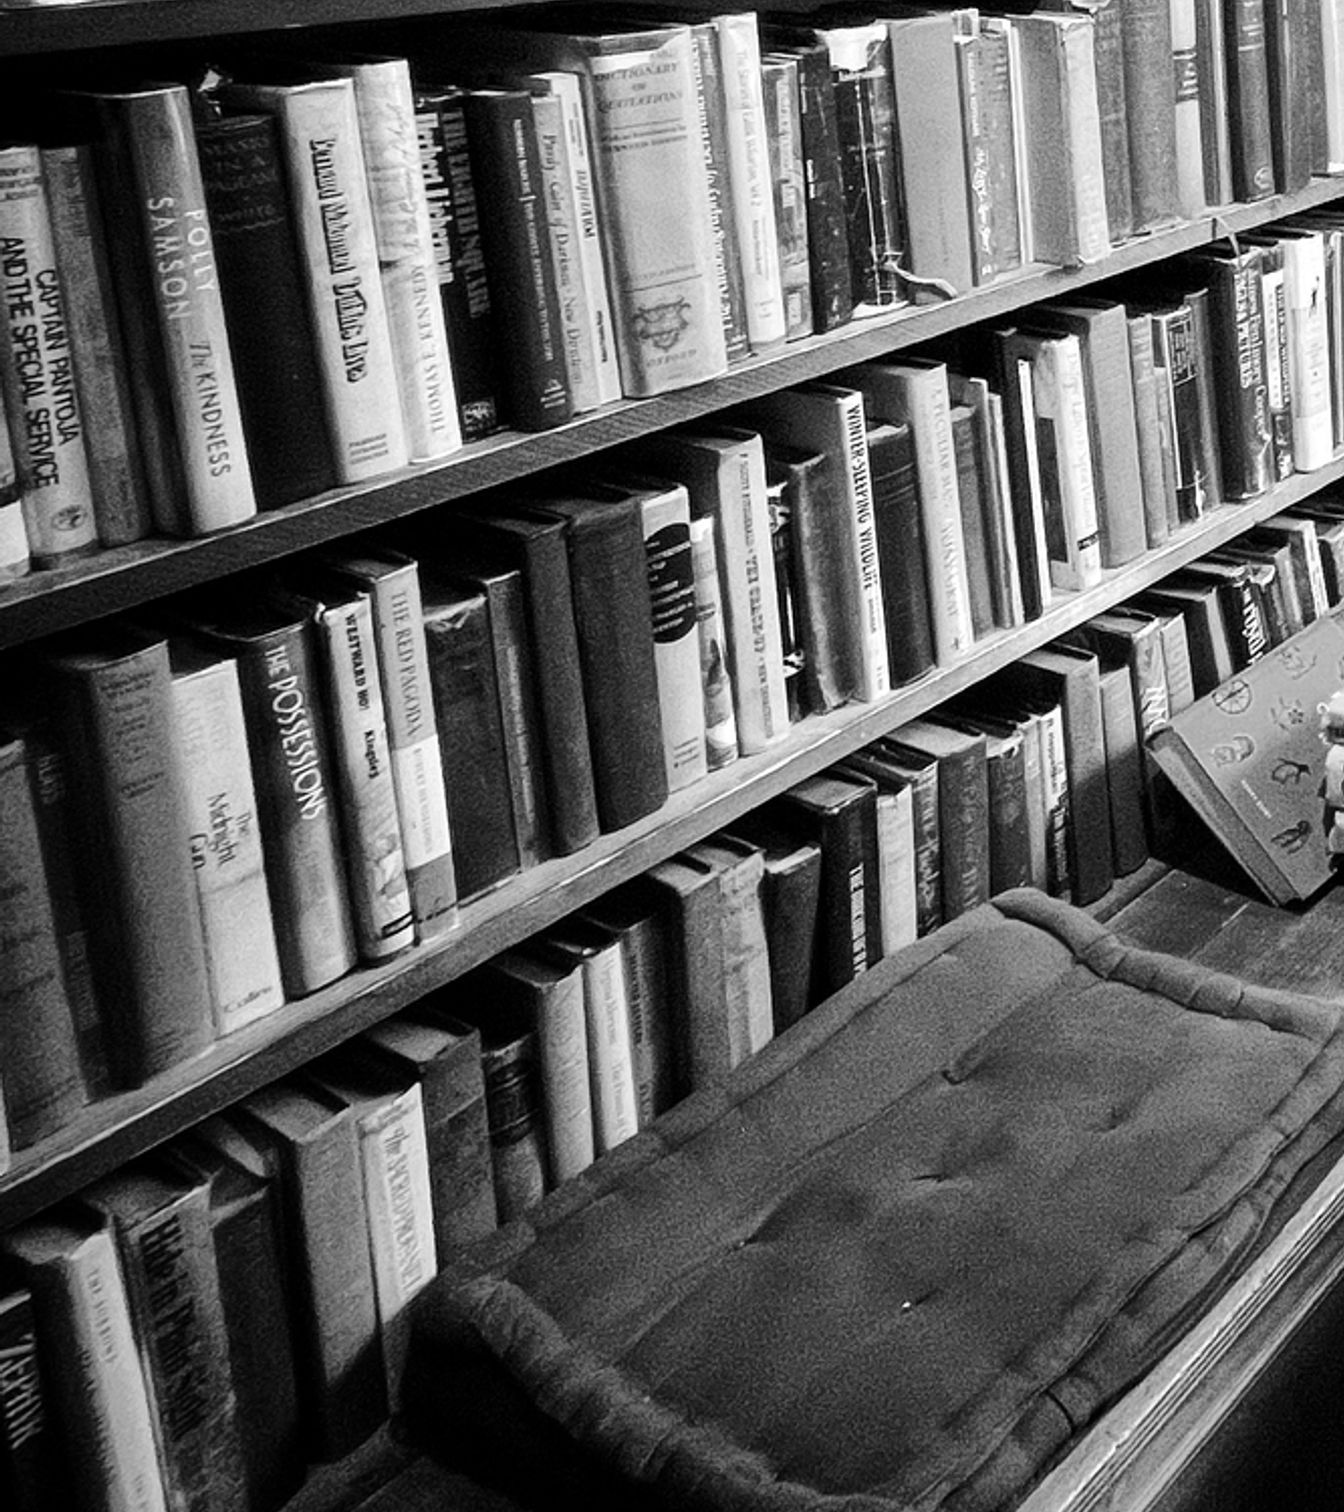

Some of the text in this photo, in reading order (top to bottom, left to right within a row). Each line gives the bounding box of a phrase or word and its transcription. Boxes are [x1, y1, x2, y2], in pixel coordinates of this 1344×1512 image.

[310, 139, 344, 199] Bernard
[416, 112, 445, 186] Herbert
[0, 238, 28, 277] AND
[146, 196, 191, 319] SAMSON
[184, 209, 216, 292] POLLY
[321, 203, 357, 275] Malamud
[5, 278, 34, 319] THE
[411, 263, 433, 341] KENNEDY
[11, 324, 45, 405] SPECIAL
[37, 269, 80, 446] CAPTAIN PANTOJA
[195, 372, 232, 478] KINDNESS
[426, 362, 446, 433] THOMAS
[24, 407, 59, 487] SERVICE
[846, 404, 872, 524] WINTER-SLEEPING
[859, 527, 879, 591] WILDLIFE
[345, 613, 368, 687] WESTWARD
[364, 729, 381, 780] Kingsley
[391, 590, 424, 738] THE RED PAGODA
[264, 645, 329, 821] THE POSSESSIONS
[207, 792, 240, 867] Midnight
[140, 1213, 188, 1280] Hide
[156, 1298, 196, 1377] Plain
